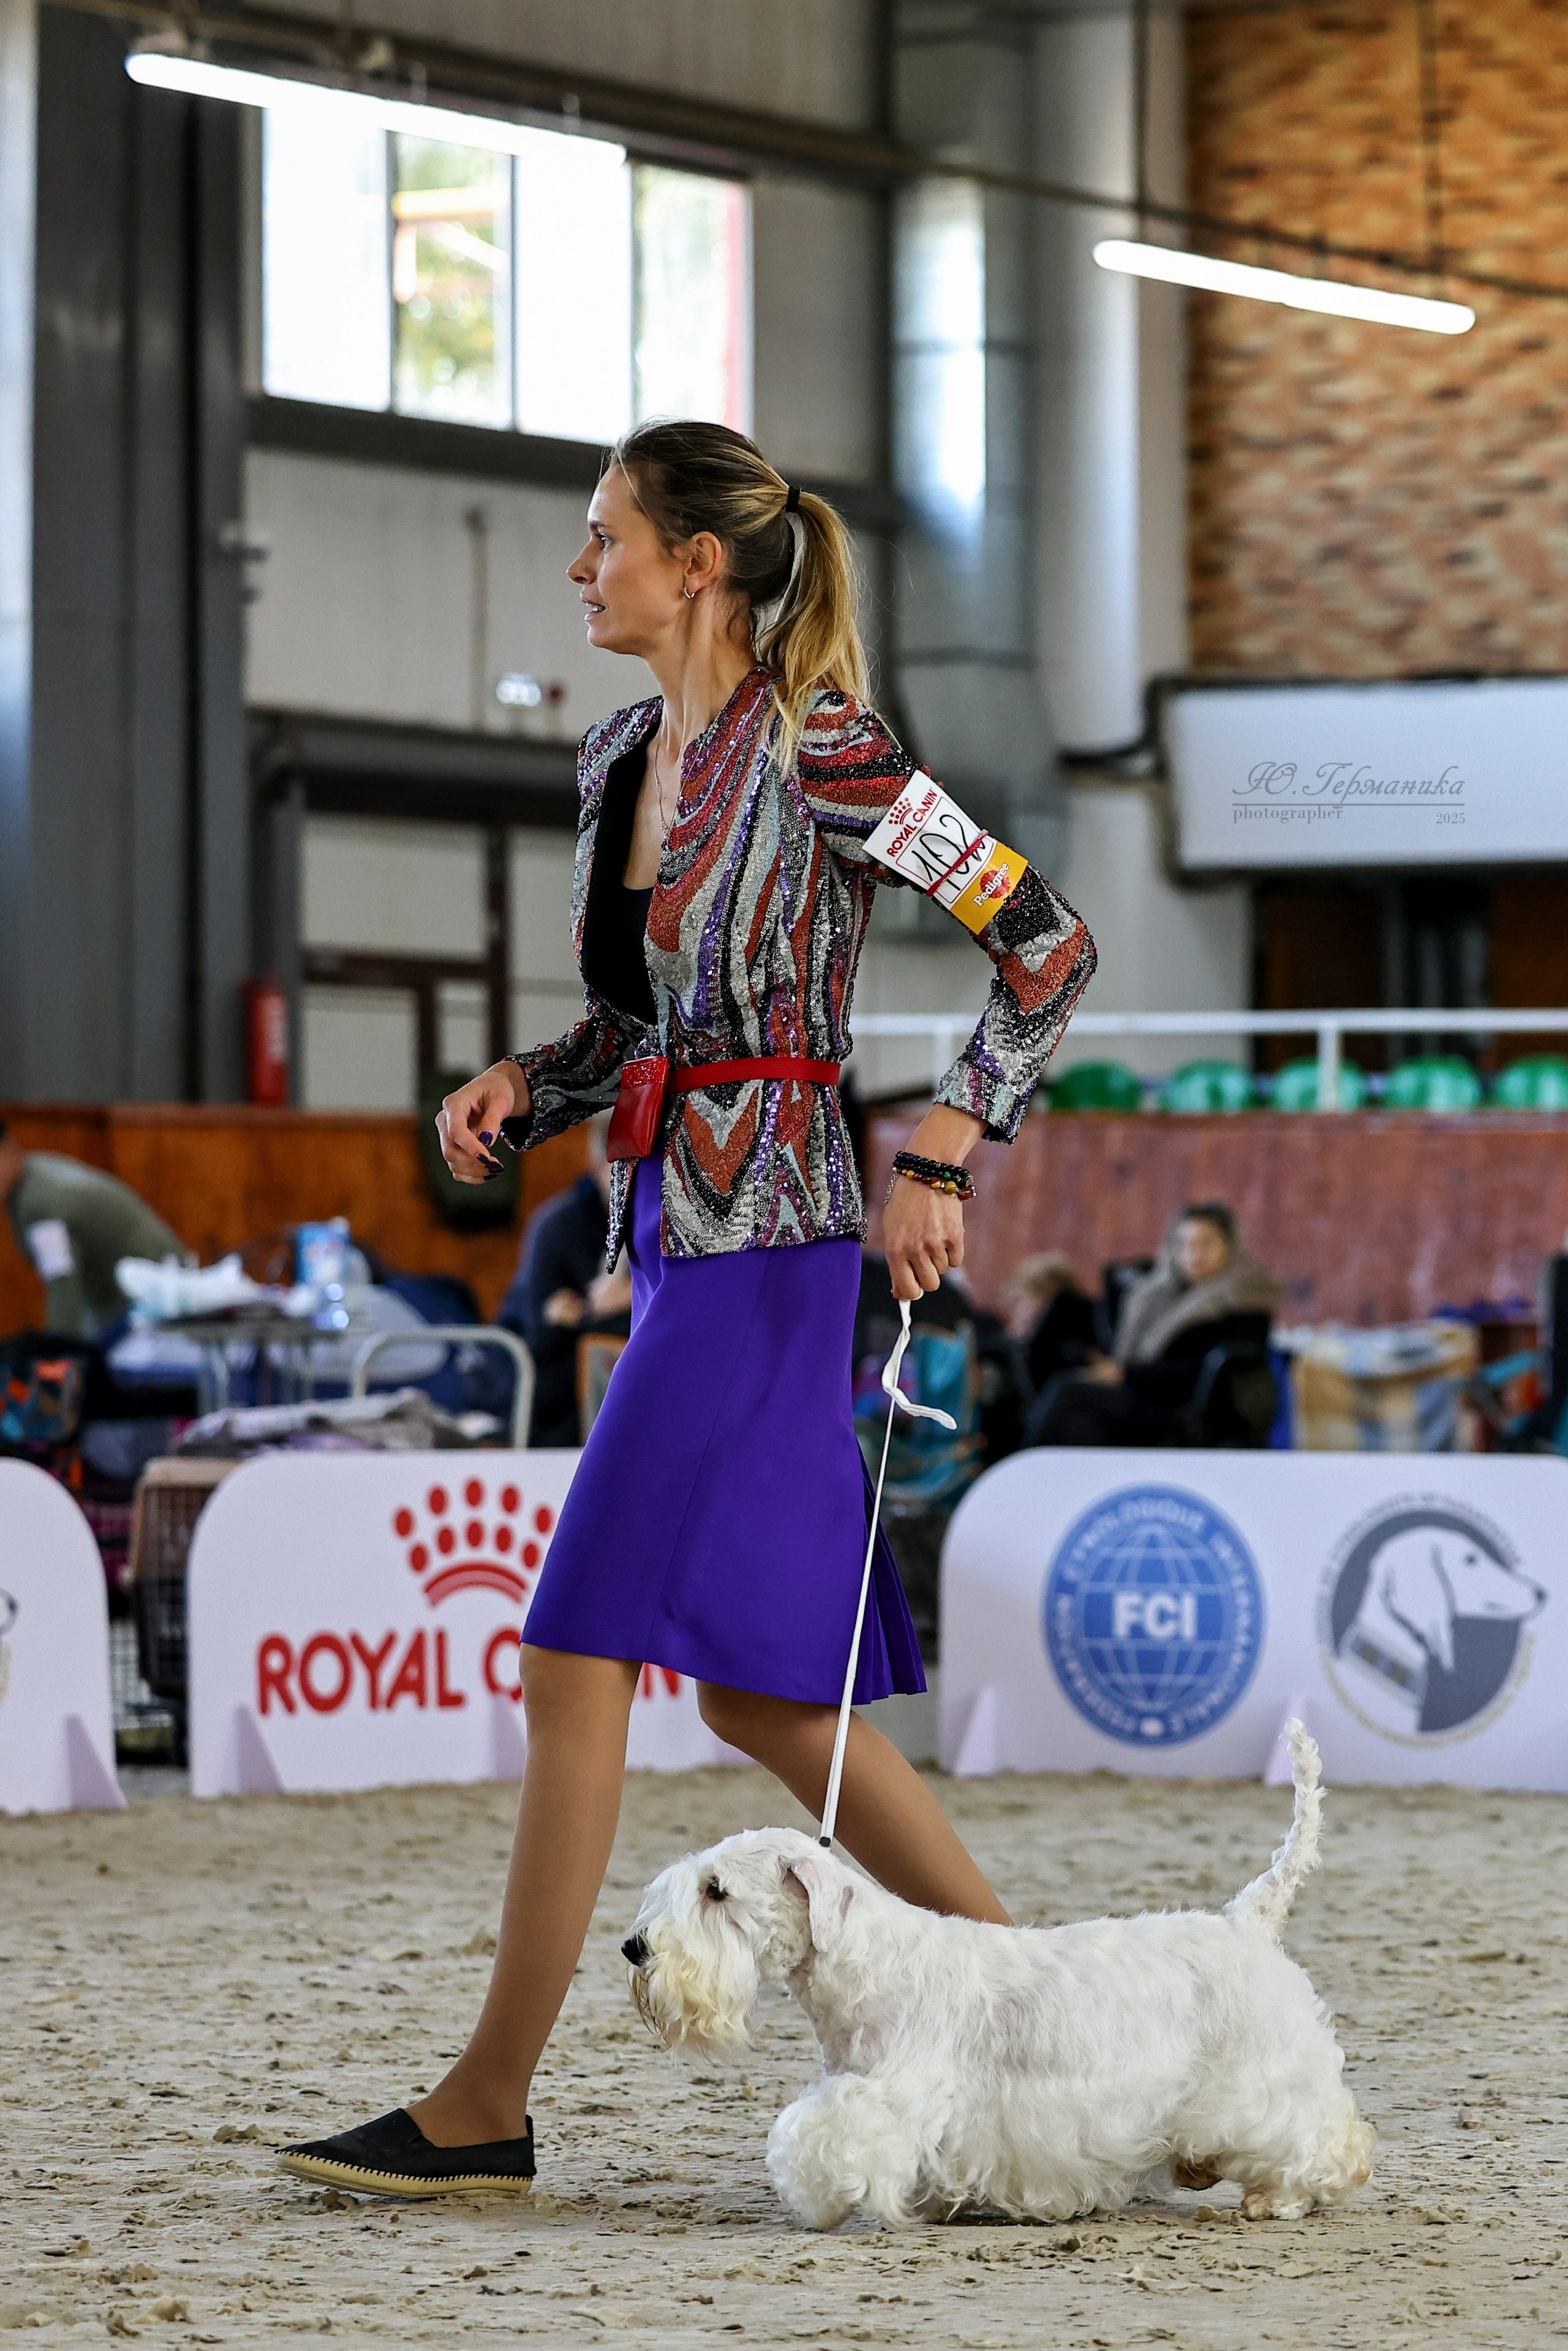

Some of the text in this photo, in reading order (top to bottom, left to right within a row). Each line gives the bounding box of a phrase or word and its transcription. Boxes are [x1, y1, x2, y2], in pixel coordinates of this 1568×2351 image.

[886, 788, 938, 858] ROYAL CANIN
[973, 862, 1010, 908] Pedigree
[1112, 1593, 1197, 1640] FCI
[257, 1627, 465, 1715] ROYAL
